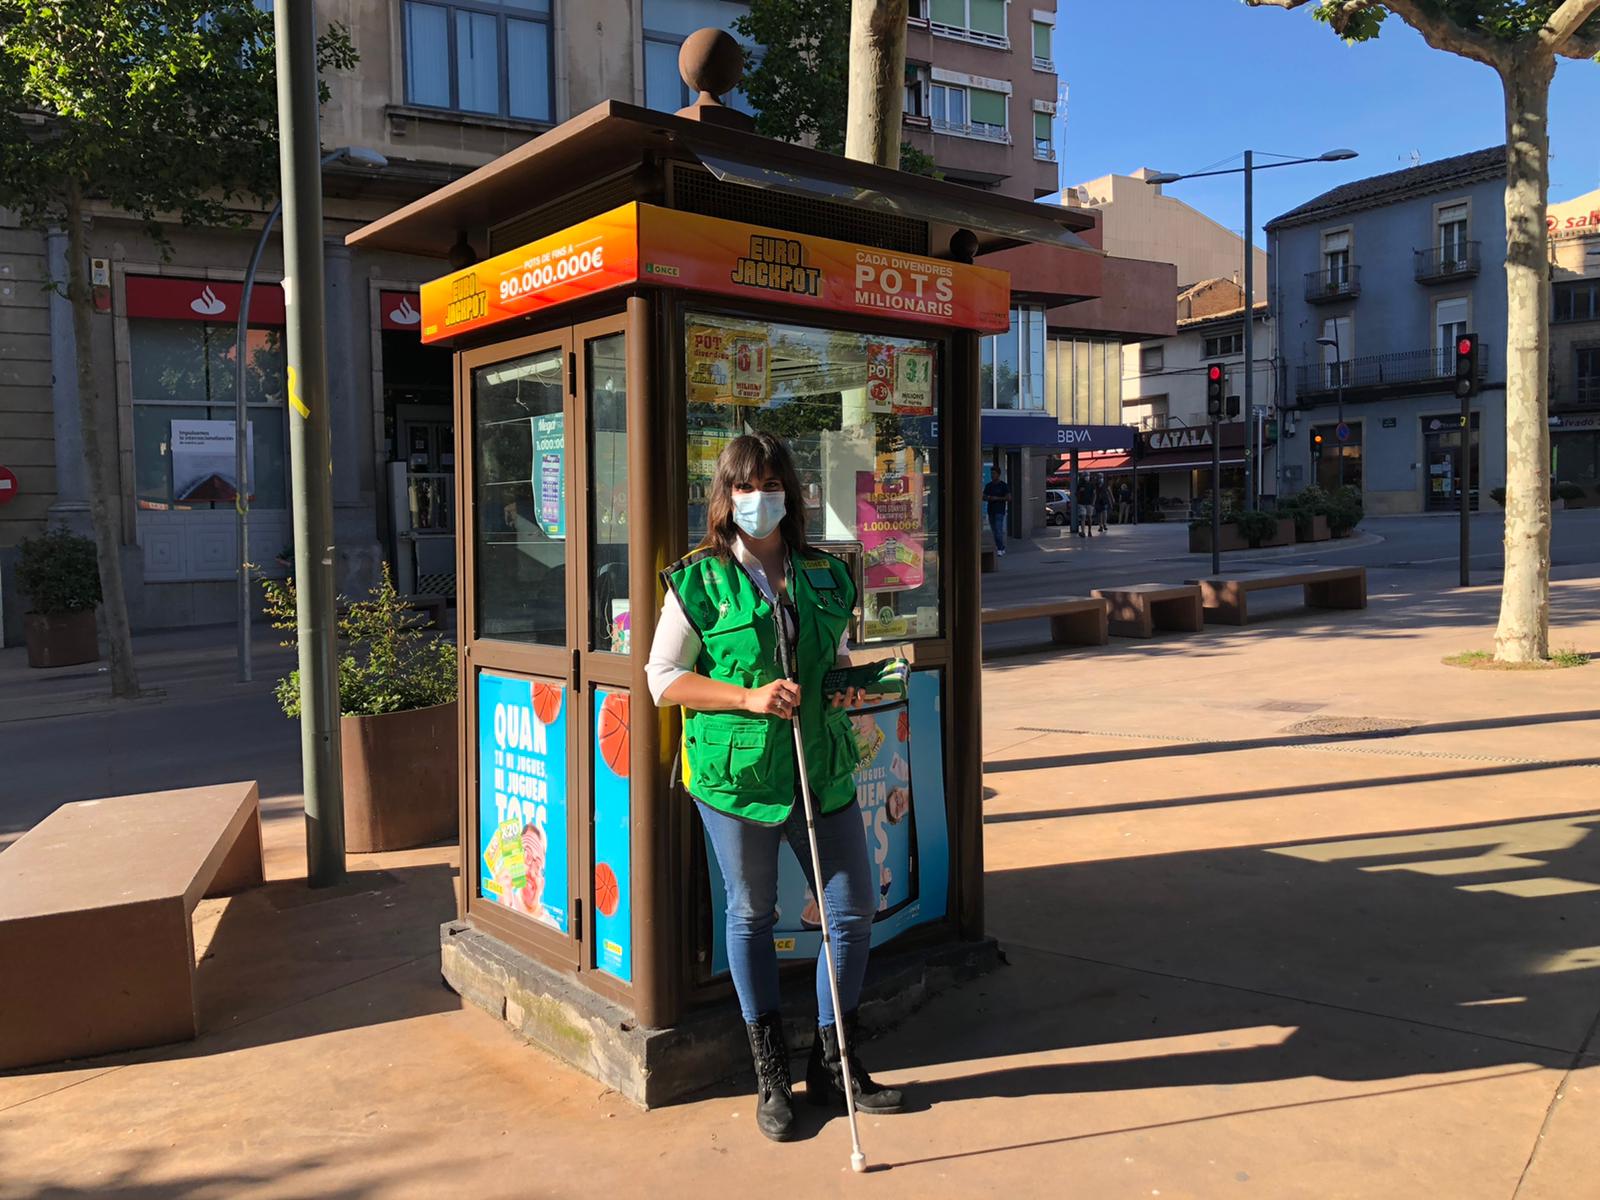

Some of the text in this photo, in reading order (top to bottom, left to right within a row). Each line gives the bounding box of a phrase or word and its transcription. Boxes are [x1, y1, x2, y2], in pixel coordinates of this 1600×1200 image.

[524, 256, 540, 269] POTS
[541, 253, 551, 262] DE
[567, 244, 574, 255] A
[752, 236, 801, 266] EURO
[856, 252, 953, 277] CADA DIVENDRES
[500, 247, 603, 299] 90.000.000€
[655, 266, 678, 276] ONCE
[732, 258, 820, 296] JACKPOT
[856, 264, 953, 302] POTS
[452, 272, 477, 300] EURO
[445, 290, 488, 327] JACKPOT
[856, 290, 953, 316] MILIONARIS
[695, 335, 722, 350] POT
[738, 344, 764, 372] 61
[869, 365, 892, 378] POT
[1057, 429, 1092, 443] BBVA
[1150, 428, 1213, 449] CATALA
[494, 702, 548, 756] QUAN
[507, 771, 547, 804] JUGUEM
